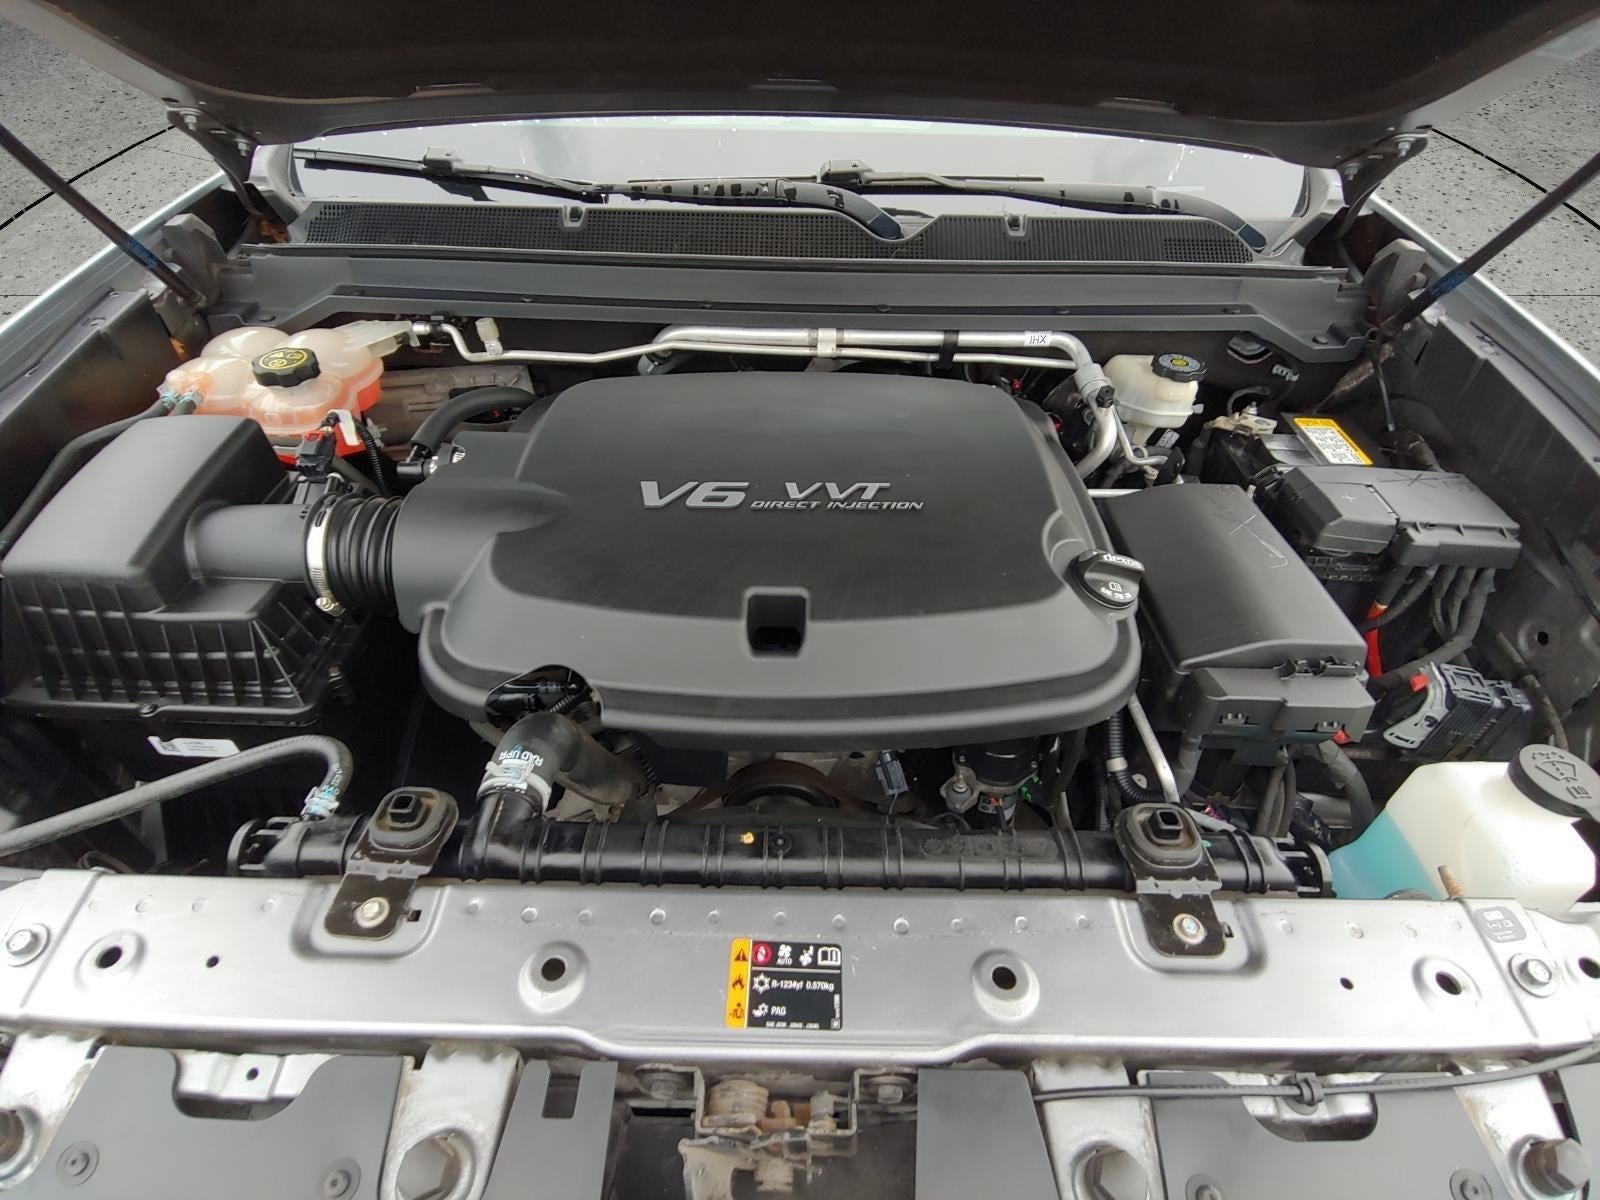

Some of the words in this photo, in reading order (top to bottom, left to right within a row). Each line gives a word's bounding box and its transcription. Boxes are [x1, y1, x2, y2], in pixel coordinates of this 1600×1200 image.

[640, 481, 750, 508] V6
[785, 482, 891, 500] VVT
[750, 500, 821, 510] DIRECT
[827, 501, 924, 511] INJECTION
[770, 1006, 787, 1016] PAG
